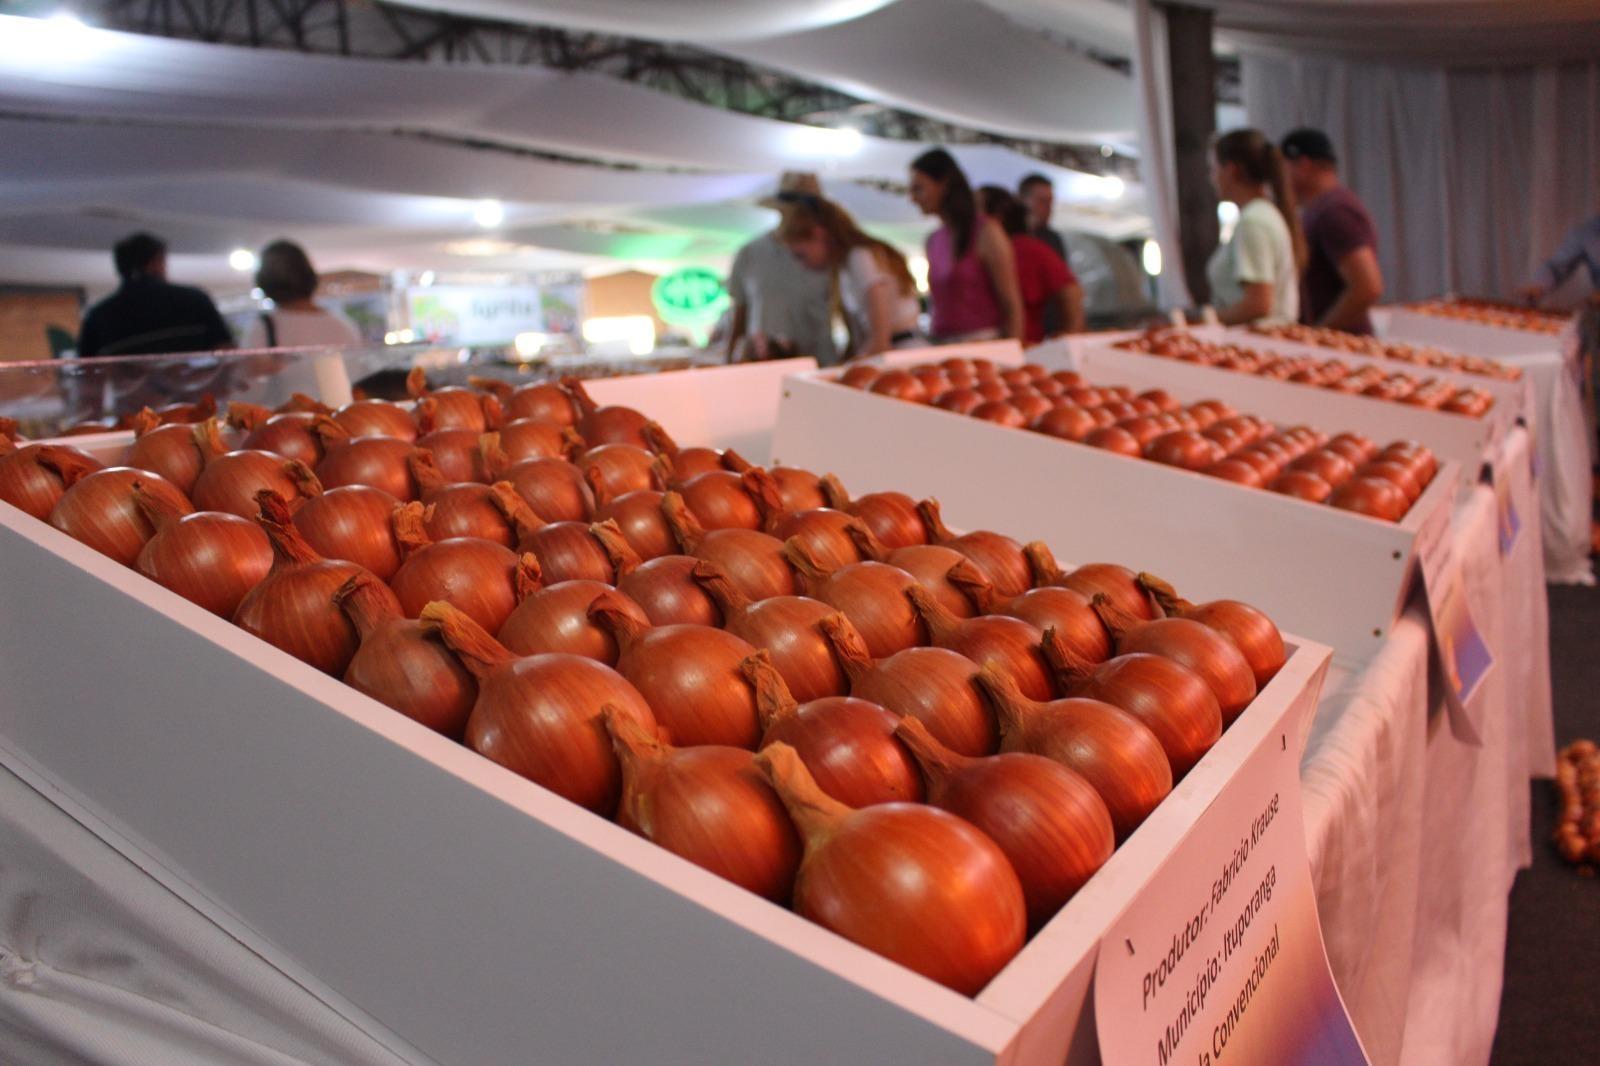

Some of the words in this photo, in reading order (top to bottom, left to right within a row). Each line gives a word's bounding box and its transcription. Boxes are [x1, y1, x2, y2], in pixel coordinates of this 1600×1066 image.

[1142, 900, 1209, 1012] Produtor:
[1250, 792, 1280, 851] Krause
[1157, 949, 1222, 1066] Município:
[1223, 864, 1277, 962] Ituporanga
[1212, 924, 1281, 1059] Convencional
